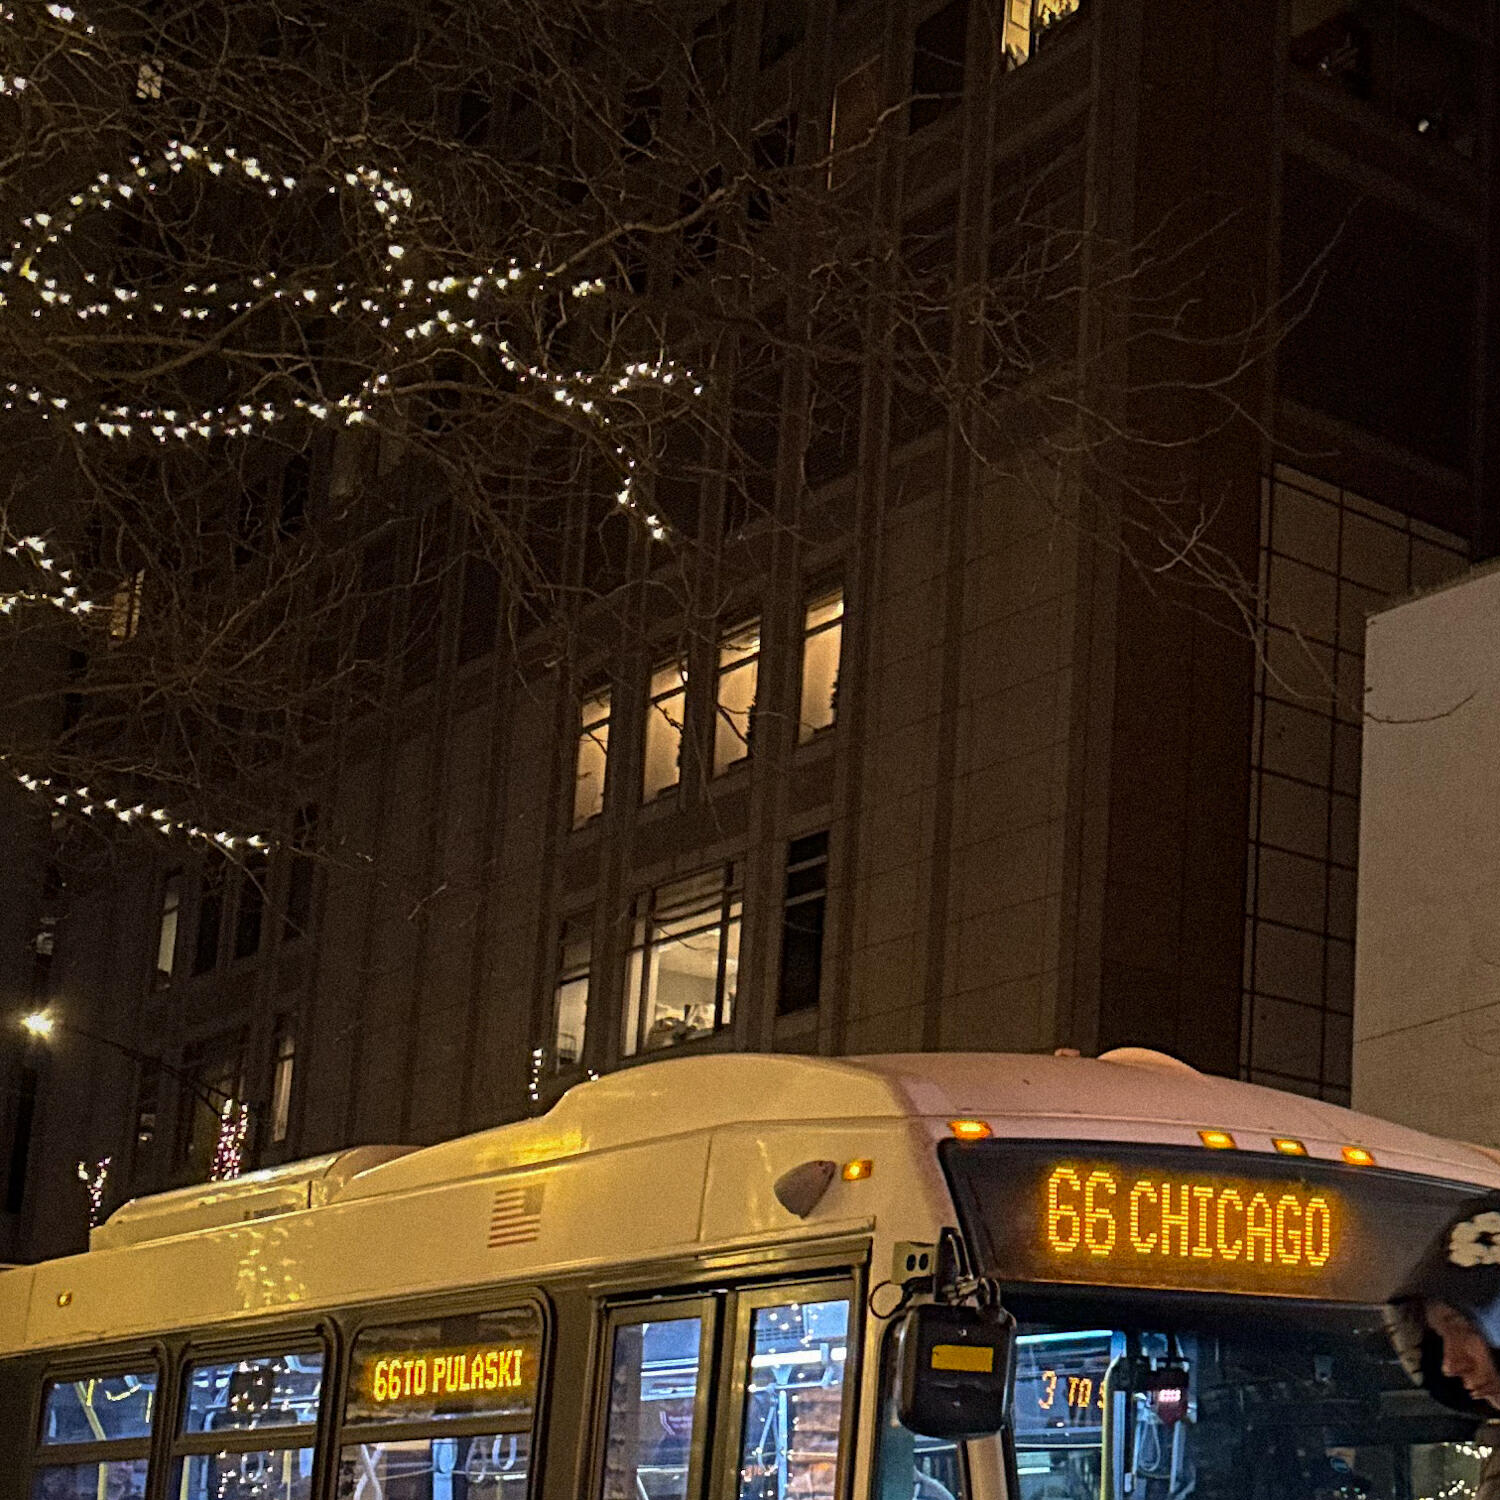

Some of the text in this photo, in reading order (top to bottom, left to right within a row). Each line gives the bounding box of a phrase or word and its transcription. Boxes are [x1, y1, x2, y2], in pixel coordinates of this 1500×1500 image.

[1048, 1167, 1330, 1266] 66 CHICAGO
[432, 1349, 523, 1392] PULASKI
